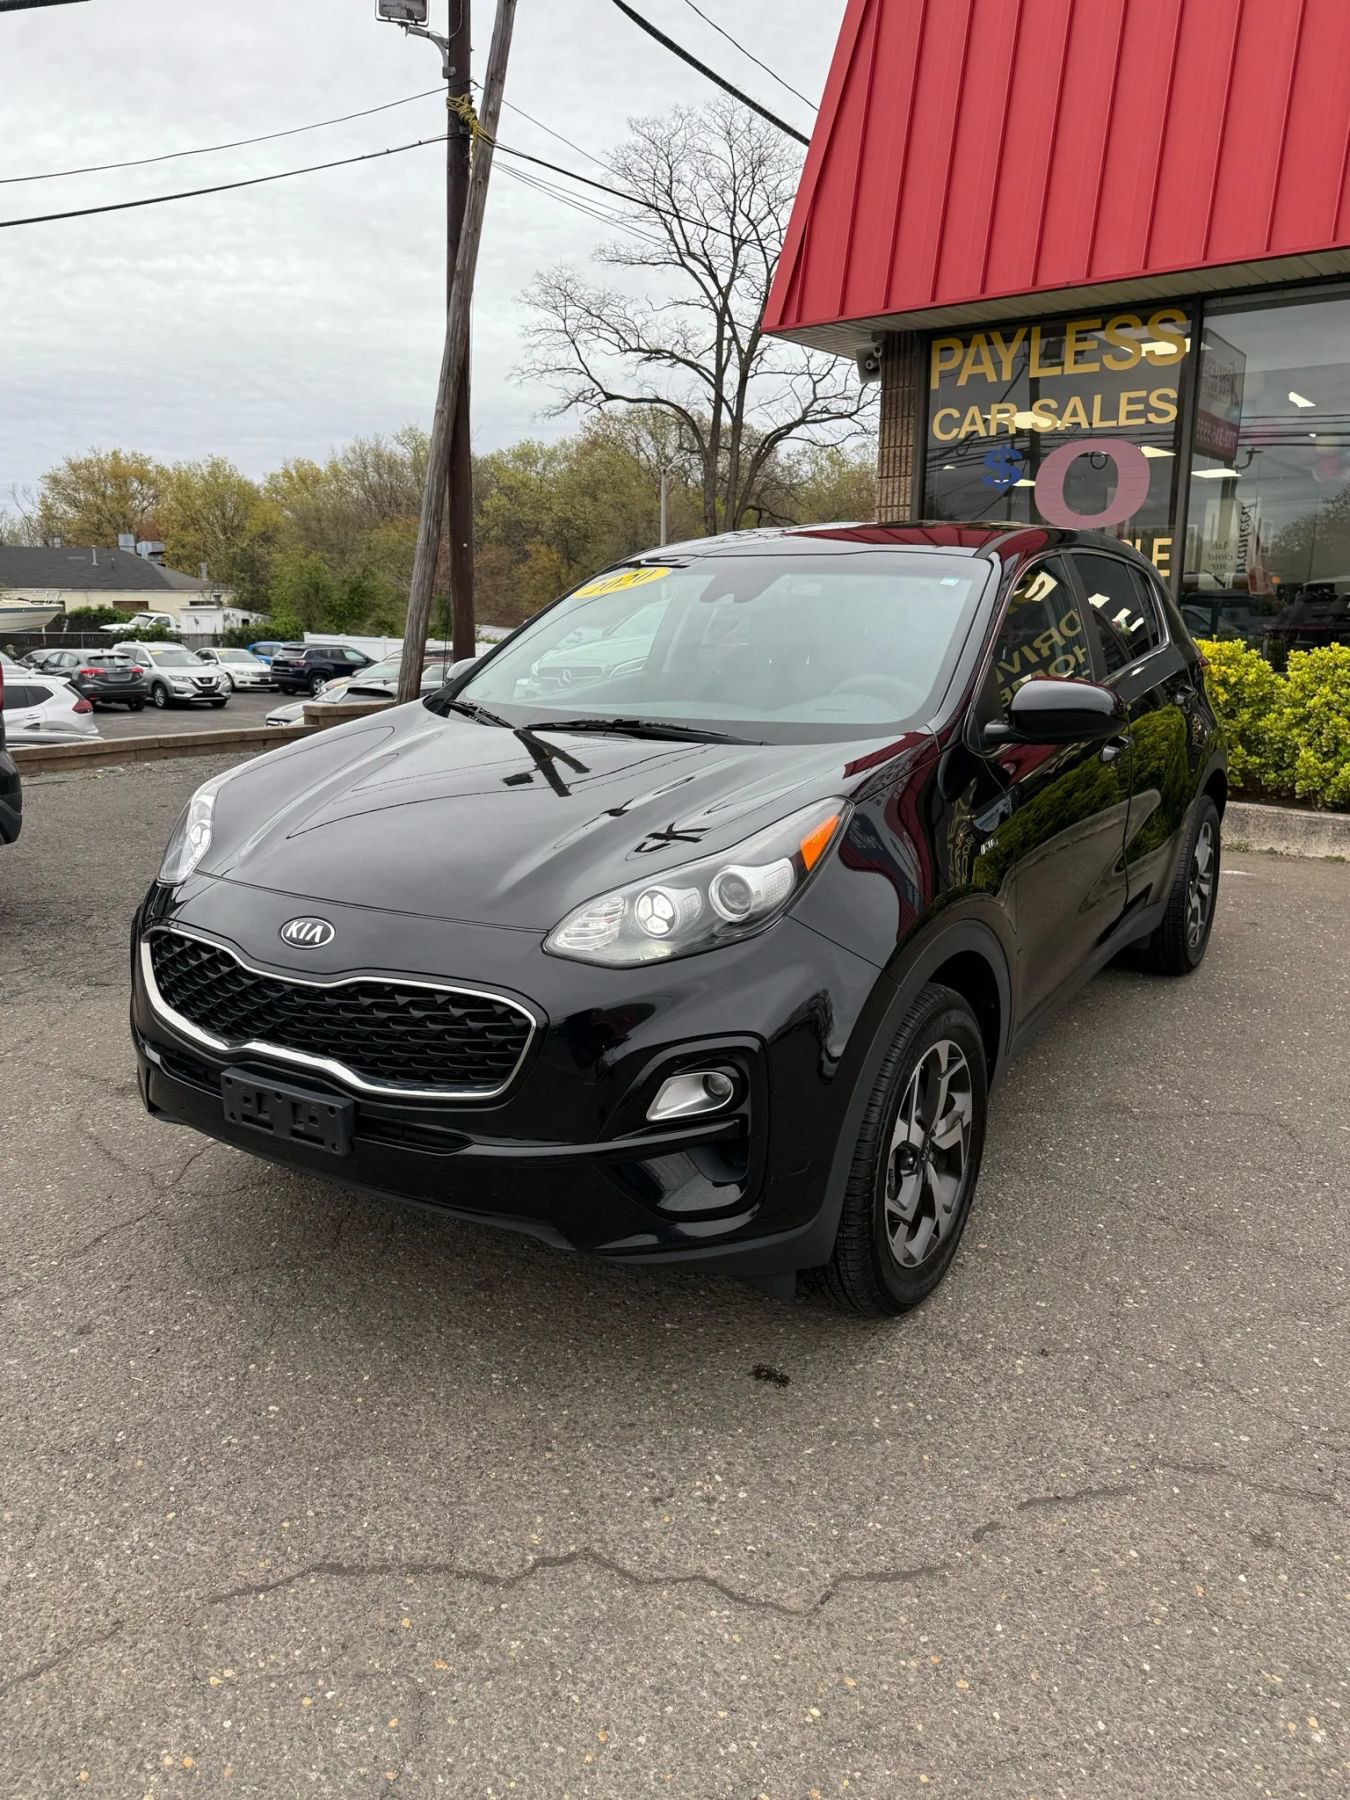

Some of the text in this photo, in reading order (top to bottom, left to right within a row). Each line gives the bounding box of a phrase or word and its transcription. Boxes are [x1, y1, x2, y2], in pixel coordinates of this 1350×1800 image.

[930, 309, 1187, 390] PAYLESS
[932, 388, 1178, 441] CAR SALES
[284, 920, 325, 943] KIA
